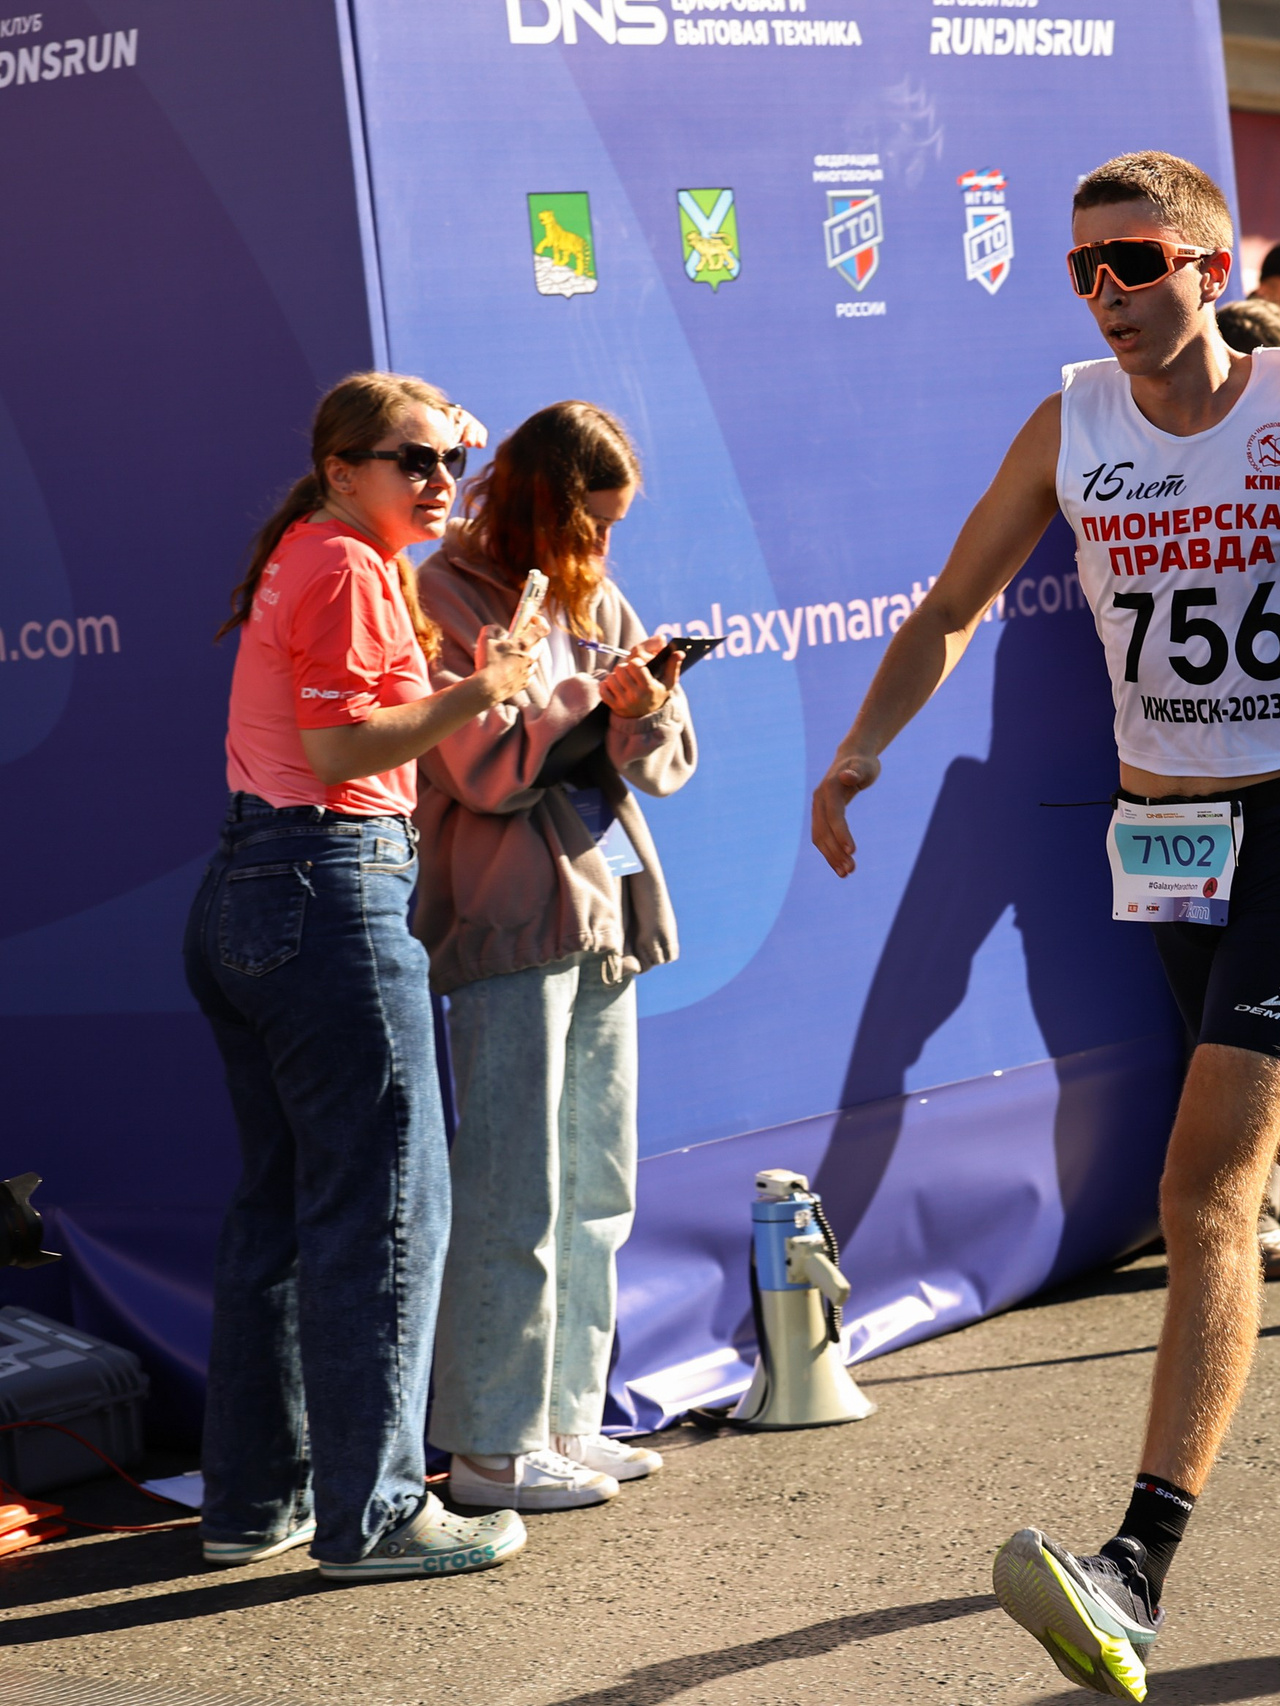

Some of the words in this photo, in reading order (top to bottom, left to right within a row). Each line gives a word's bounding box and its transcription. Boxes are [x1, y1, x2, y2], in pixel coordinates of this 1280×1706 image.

[0, 13, 43, 38] КЛУБ
[506, 0, 668, 45] DNS
[673, 19, 769, 46] БЫТОВАЯ
[771, 20, 862, 46] ТЕХНИКА
[930, 17, 1115, 56] RUNDNSRUN
[964, 191, 1005, 205] ИГРЫ
[832, 211, 875, 255] ГТО
[970, 223, 1006, 263] ГТО
[835, 302, 886, 317] РОССИИ
[1083, 462, 1134, 502] 15
[1126, 473, 1186, 500] лет
[1108, 536, 1275, 576] ПРАВДА
[1132, 835, 1215, 867] 7102
[1148, 881, 1198, 891] #GalaxyMarathon
[1206, 881, 1214, 892] A
[1178, 901, 1210, 920] 7km
[422, 1545, 496, 1572] crocs
